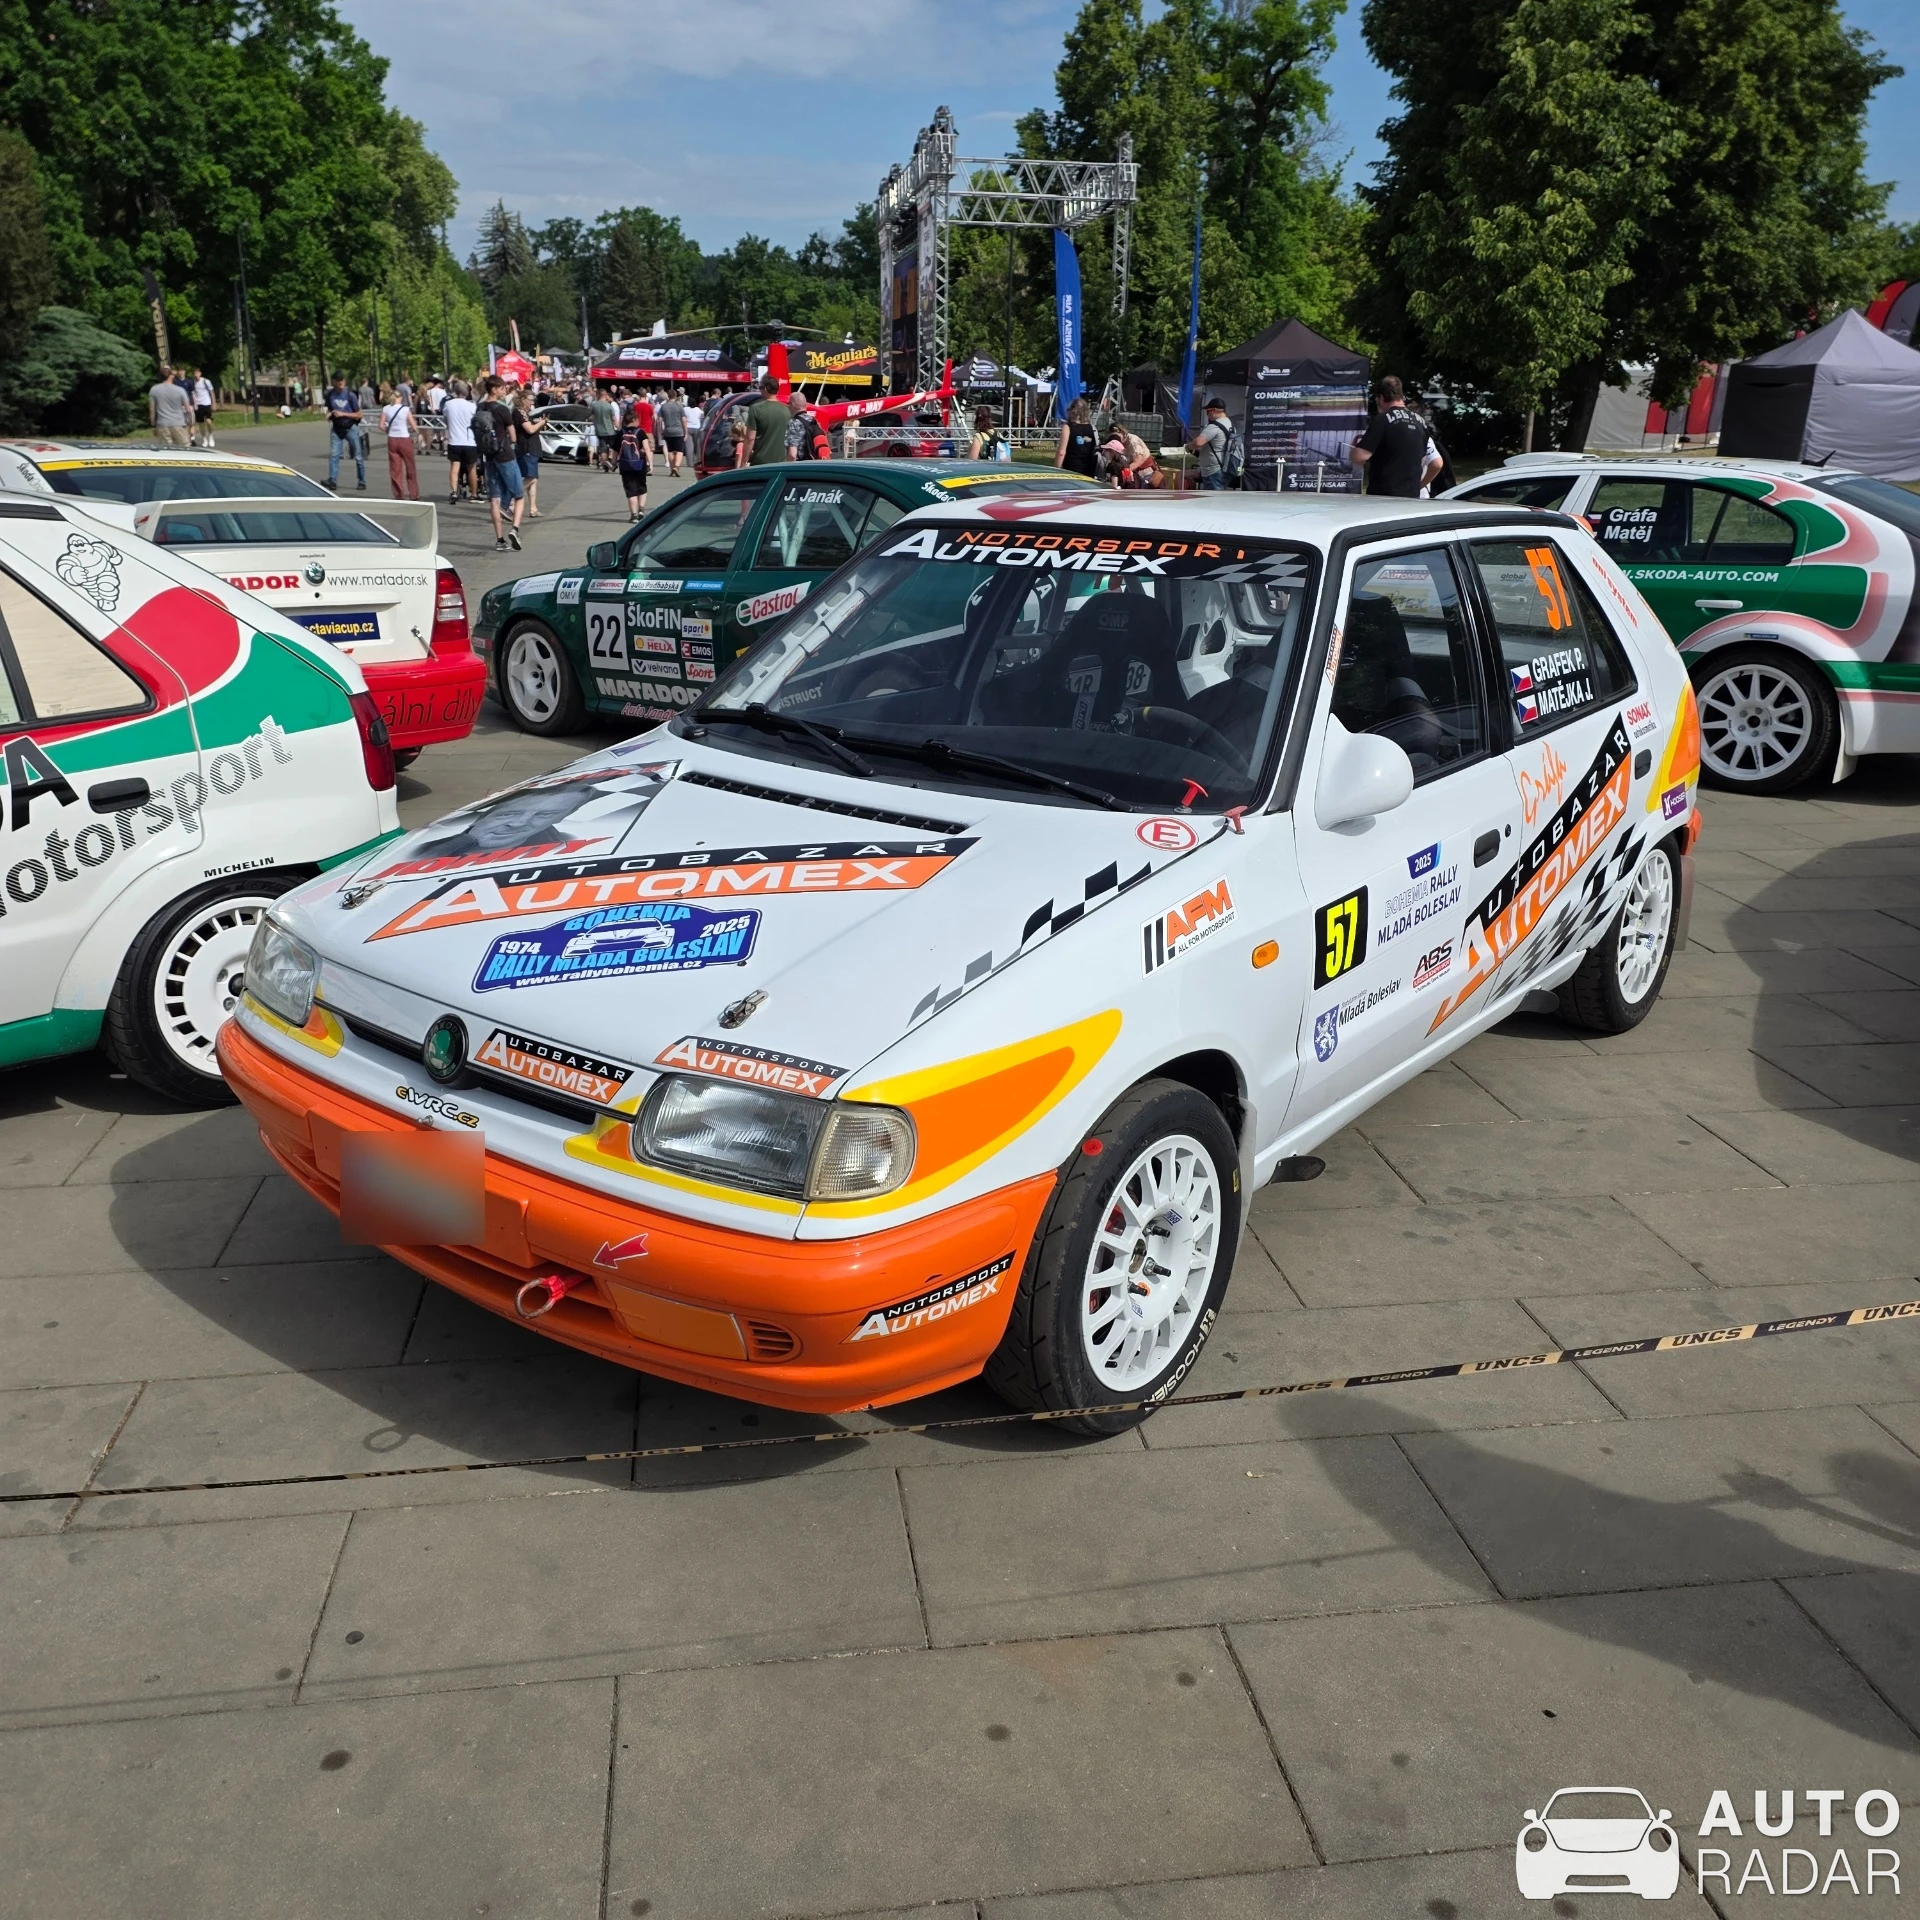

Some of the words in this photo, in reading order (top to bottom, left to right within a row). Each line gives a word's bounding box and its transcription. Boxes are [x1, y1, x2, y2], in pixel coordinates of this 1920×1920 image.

[618, 347, 722, 362] ESCAPE6
[806, 345, 879, 370] Meguiar's
[1254, 391, 1267, 400] CO
[1266, 389, 1302, 399] NABÍZÍME
[784, 487, 796, 502] J.
[799, 487, 844, 504] Janák
[1609, 507, 1658, 525] Gráfa
[1603, 524, 1654, 543] Matěj
[880, 527, 1181, 576] AUTOMEX
[327, 573, 429, 588] www.matador.sk
[1500, 573, 1527, 583] global
[1524, 546, 1573, 631] 57
[560, 591, 577, 600] OMV
[627, 601, 682, 630] ŠkoFIN
[683, 623, 705, 635] sport
[590, 613, 624, 660] 22
[647, 641, 675, 652] HELIX
[691, 646, 712, 657] EMOS
[1532, 649, 1574, 683] GRAFEK
[1574, 647, 1585, 670] P.
[647, 663, 679, 676] velvana
[686, 663, 715, 680] Sport
[621, 701, 645, 716] Auto
[1538, 685, 1583, 716] MATĚJKA
[1582, 682, 1594, 702] J.
[1626, 701, 1652, 726] SONAX
[203, 856, 275, 878] MICHELIN
[1414, 852, 1432, 873] 2025
[402, 858, 911, 934] AUTOMEX
[1384, 880, 1430, 919] BOHEMIA
[1429, 864, 1459, 894] RALLY
[1445, 772, 1625, 1008] AUTOMEX
[563, 904, 691, 931] BOHEMIA
[700, 914, 751, 939] 2025
[1166, 879, 1234, 948] AFM
[1377, 909, 1413, 947] MLADÁ
[1413, 884, 1462, 926] BOLESLAV
[1178, 943, 1189, 954] ALL
[1188, 933, 1201, 947] FOR
[1199, 911, 1235, 939] MOTORSPORT
[1325, 895, 1359, 979] 57
[499, 940, 543, 955] 1974
[1414, 936, 1456, 979] ABS
[483, 953, 552, 982] RALLY
[515, 959, 703, 987] www.rallybohemia.cz
[1338, 996, 1366, 1028] Mladá
[1366, 977, 1402, 1010] Boleslav
[481, 1032, 612, 1100] AUTOMEX
[662, 1038, 823, 1094] AUTOMEX
[396, 1085, 480, 1129] eWRC.cz
[850, 1276, 1000, 1342] AUTOMEX
[831, 1427, 910, 1438] UNCS
[1049, 1405, 1125, 1418] UNCS
[1259, 1380, 1333, 1396] UNCS
[1361, 1369, 1434, 1385] LEGENDY
[1474, 1353, 1547, 1372] UNCS
[1574, 1341, 1645, 1358] LEGENDY
[1672, 1327, 1743, 1346] UNCS
[1767, 1315, 1838, 1334] LEGENDY
